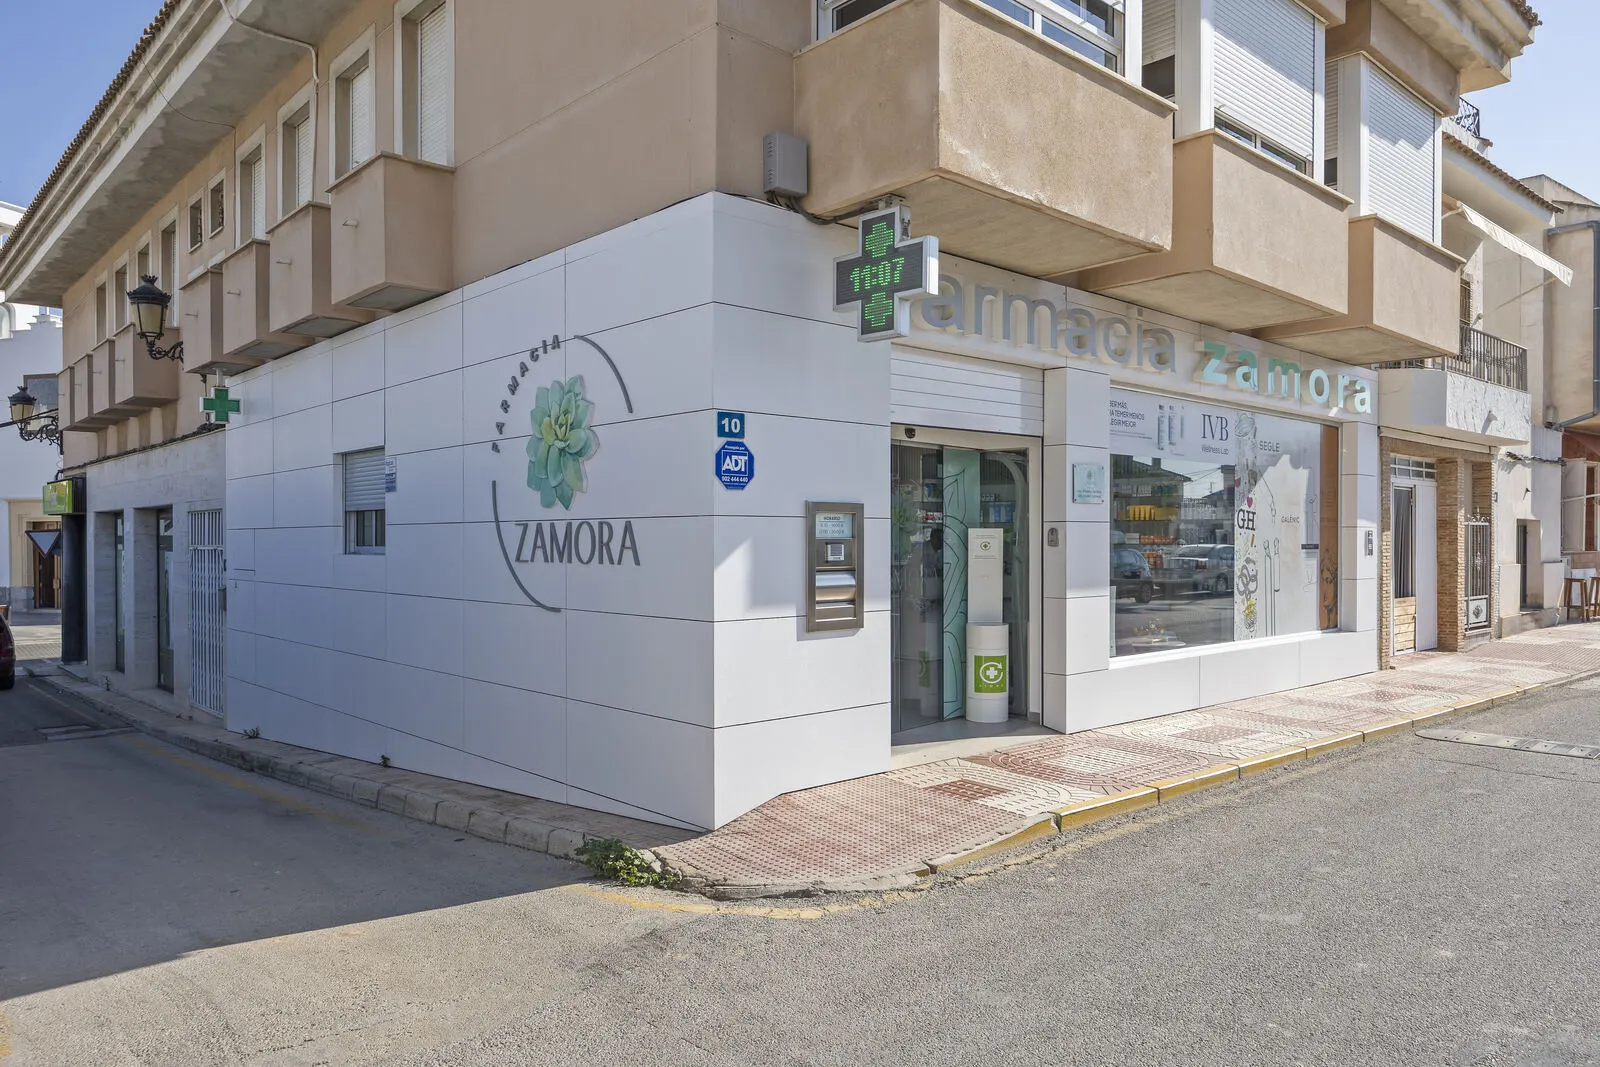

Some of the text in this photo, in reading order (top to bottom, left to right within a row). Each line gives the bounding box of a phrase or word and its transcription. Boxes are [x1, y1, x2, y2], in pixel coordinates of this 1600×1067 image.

[850, 257, 905, 292] 11:07
[920, 273, 1372, 414] armacia zamora
[491, 334, 561, 454] FARMACIA
[721, 417, 741, 433] 10
[1201, 413, 1229, 442] IVB
[1259, 440, 1280, 453] SEGLE
[723, 456, 748, 472] ADT
[1236, 508, 1256, 531] GH
[514, 520, 641, 566] ZAMORA
